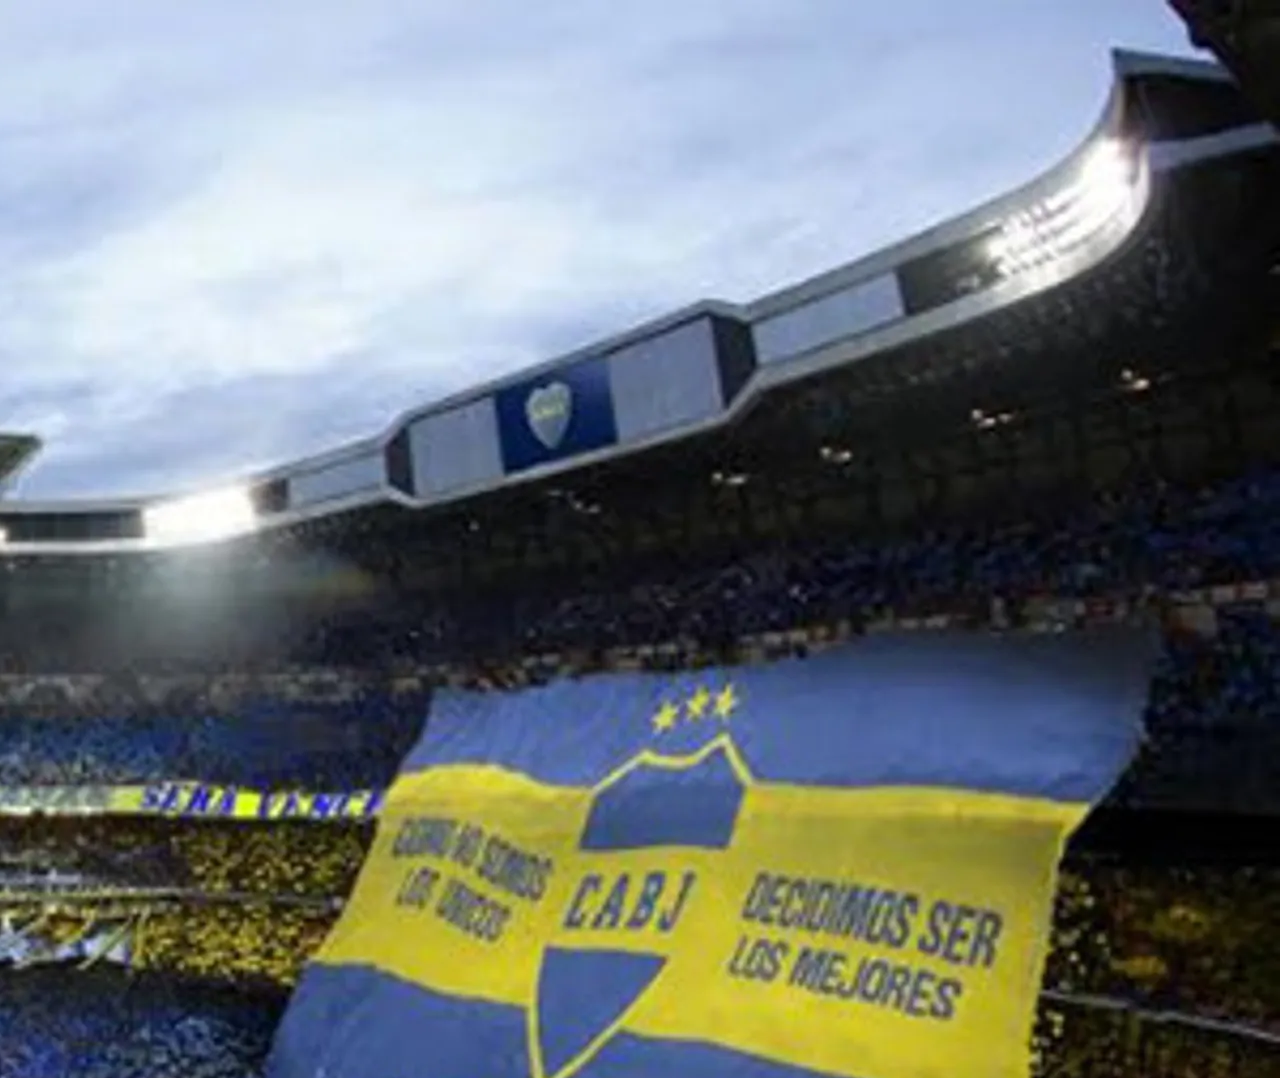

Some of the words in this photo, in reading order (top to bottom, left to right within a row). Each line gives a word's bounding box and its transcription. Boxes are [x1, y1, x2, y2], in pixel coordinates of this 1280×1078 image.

[563, 871, 696, 932] CABJ
[741, 872, 919, 948] DECIDIMOS
[918, 899, 1003, 968] SER
[729, 935, 788, 981] LOS
[788, 947, 963, 1020] MEJORES
